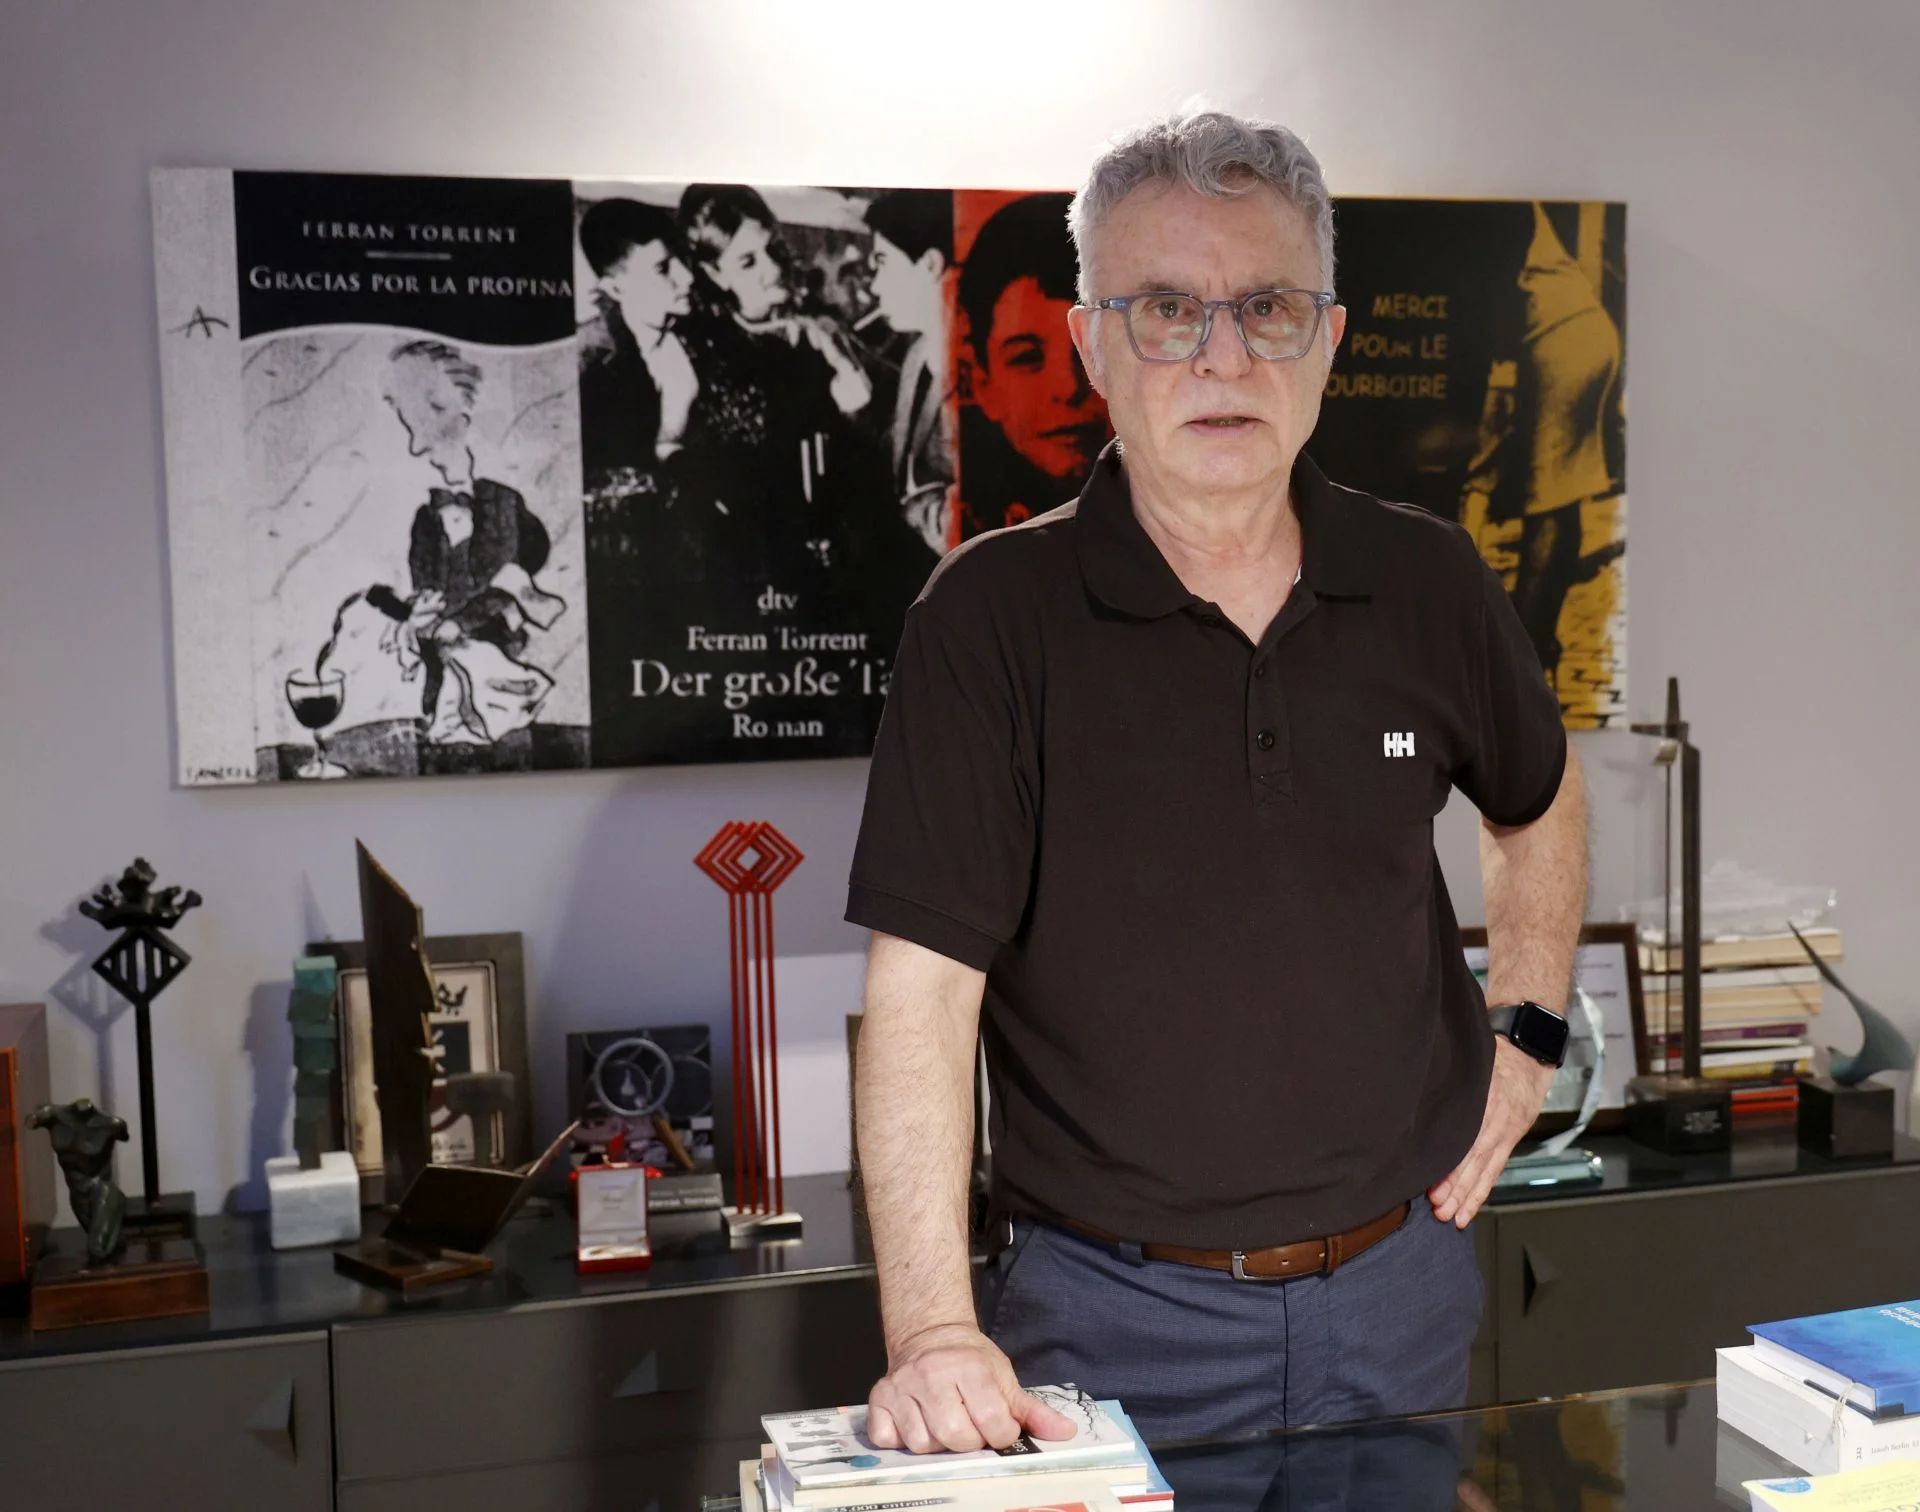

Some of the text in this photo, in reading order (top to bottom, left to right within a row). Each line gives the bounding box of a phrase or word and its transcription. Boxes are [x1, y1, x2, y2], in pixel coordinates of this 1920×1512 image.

[302, 221, 518, 244] FERRAN TORRENT
[248, 266, 573, 297] GRACIAS POR LA PROPINA
[1371, 294, 1449, 319] MERCI
[1420, 334, 1448, 359] LE
[1325, 373, 1448, 399] OURBOIRE
[757, 585, 799, 610] dtv
[687, 626, 868, 651] Ferran Torrent
[630, 657, 892, 710] Der große Ta
[732, 713, 825, 738] Roman
